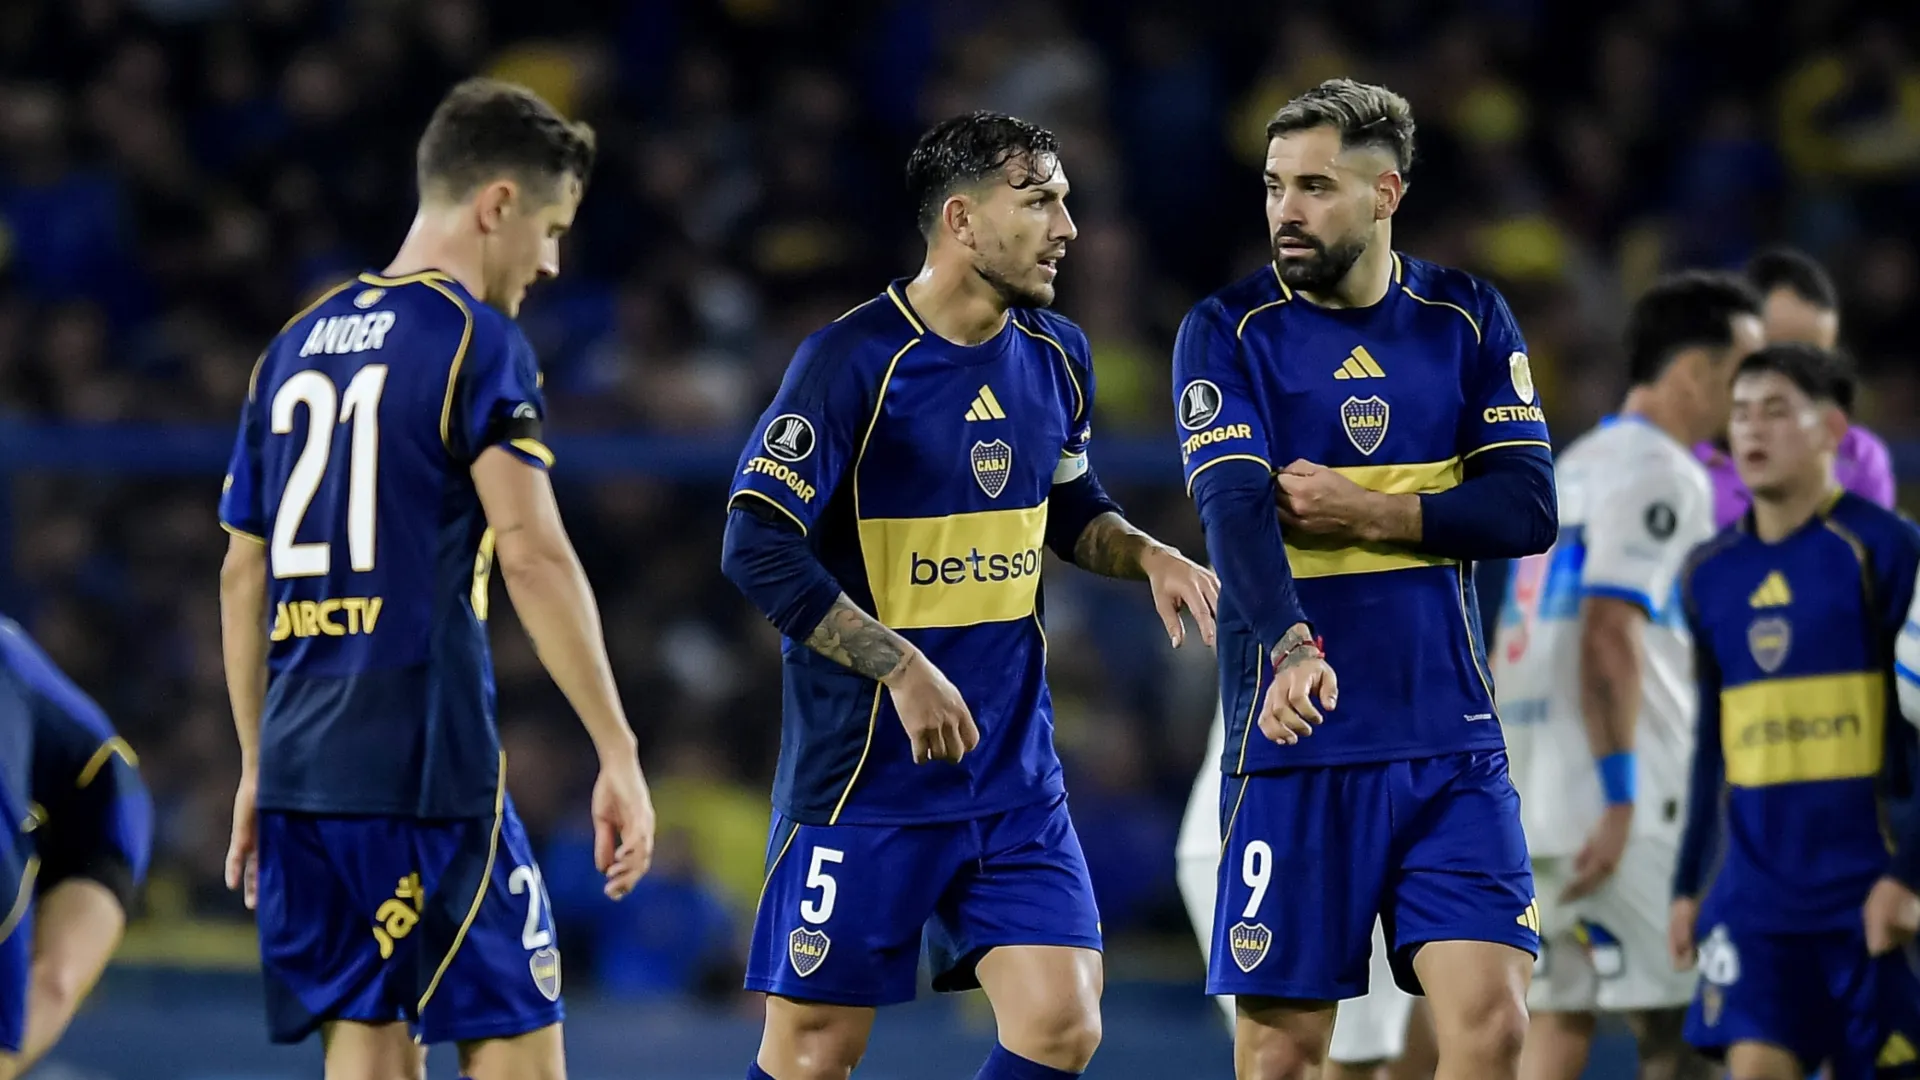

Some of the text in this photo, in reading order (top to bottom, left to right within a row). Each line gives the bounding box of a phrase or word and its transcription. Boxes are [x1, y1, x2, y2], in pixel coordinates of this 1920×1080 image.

[299, 311, 395, 357] ANDER
[1349, 415, 1382, 428] CABJ
[271, 364, 388, 579] 21
[976, 459, 1007, 473] CABJ
[800, 846, 844, 924] 5
[1242, 840, 1273, 919] 9
[794, 942, 822, 957] CABJ
[1235, 938, 1265, 951] CABJ
